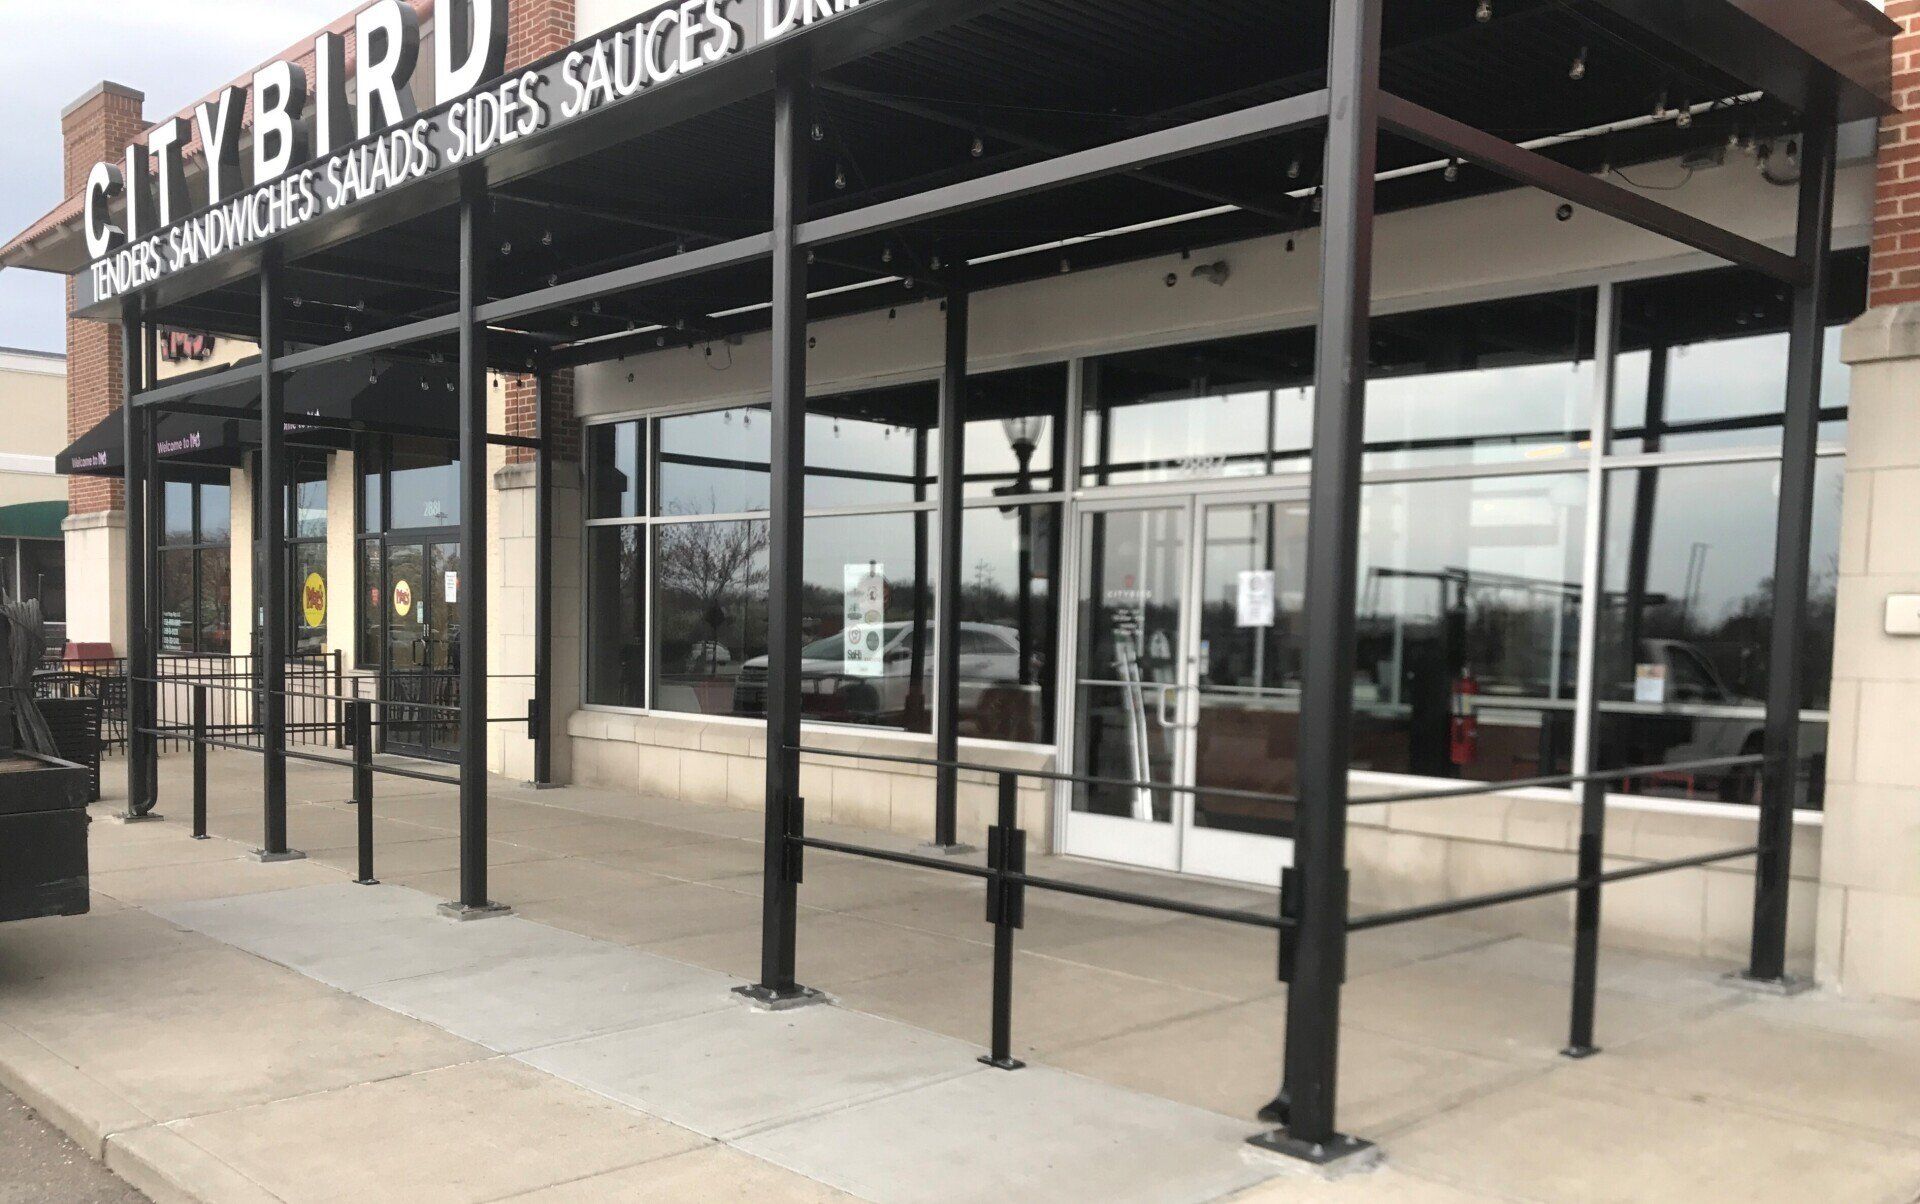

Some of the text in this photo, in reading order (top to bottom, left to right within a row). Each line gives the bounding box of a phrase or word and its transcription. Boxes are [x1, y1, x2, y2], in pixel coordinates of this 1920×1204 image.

[83, 0, 496, 259] CITYBIRD
[91, 235, 161, 303] TENDERS
[168, 168, 317, 272] SANDWICHES
[326, 119, 430, 210] SALADS
[446, 70, 541, 164] SIDES
[560, 0, 733, 118] SAUCES
[71, 457, 92, 468] Welcome
[156, 440, 182, 454] Welcome
